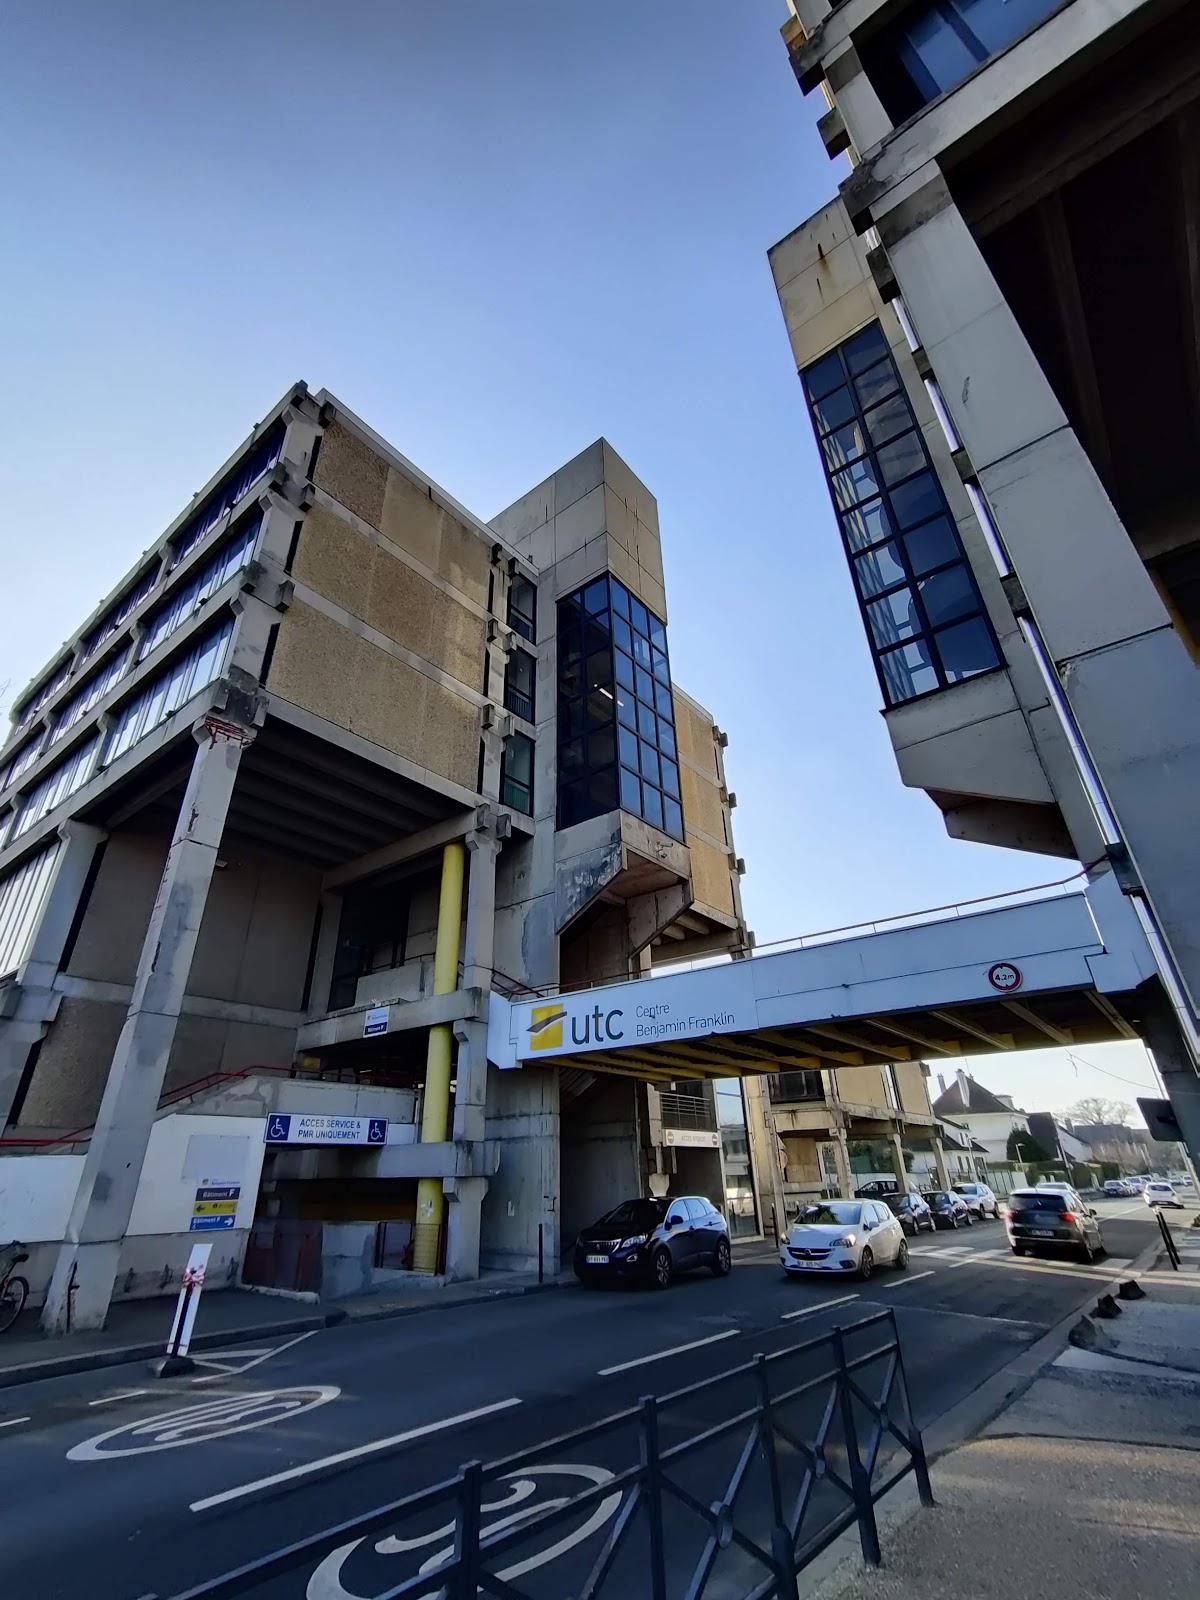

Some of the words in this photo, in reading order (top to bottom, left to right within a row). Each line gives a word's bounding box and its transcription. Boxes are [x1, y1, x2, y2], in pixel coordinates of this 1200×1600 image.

[571, 1005, 624, 1045] utc
[635, 1004, 670, 1018] Centre
[636, 1018, 686, 1038] Benjamin
[688, 1011, 735, 1030] Franklin
[300, 1118, 325, 1128] ACCES
[326, 1119, 355, 1129] SERVICE
[356, 1120, 361, 1129] &
[298, 1130, 314, 1139] PMR
[315, 1131, 360, 1139] UNIQUEMENT
[229, 1189, 235, 1197] F
